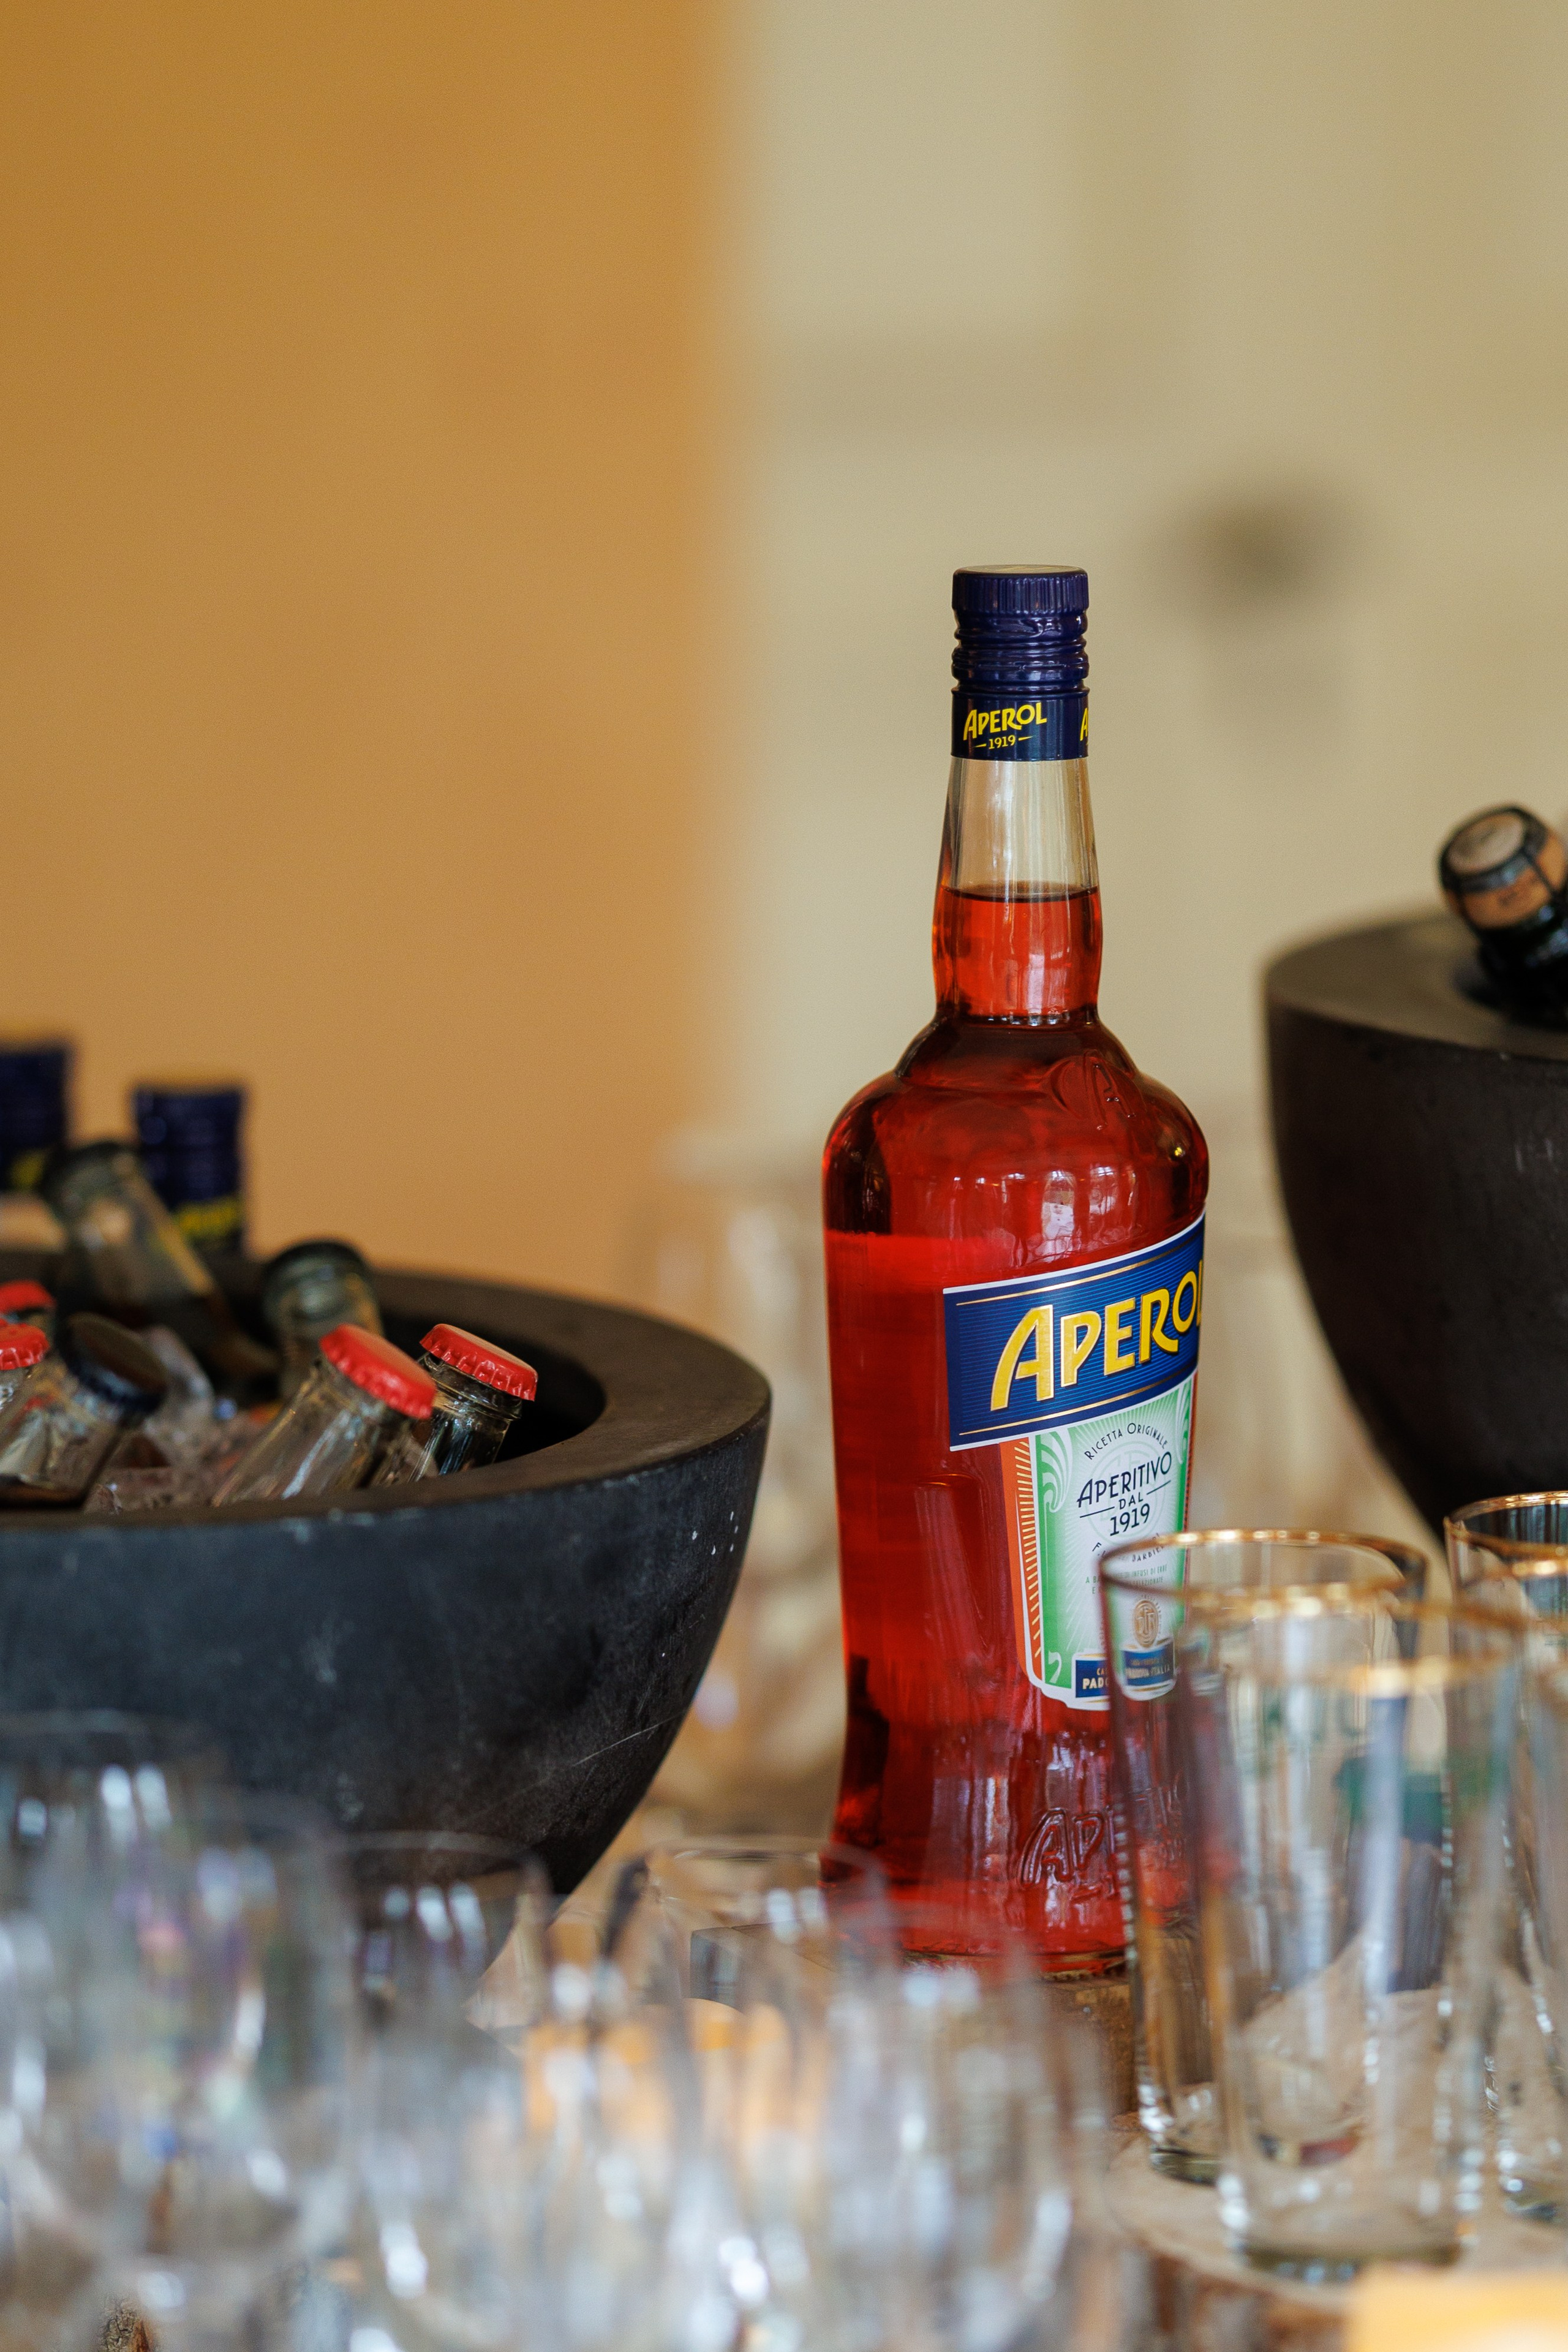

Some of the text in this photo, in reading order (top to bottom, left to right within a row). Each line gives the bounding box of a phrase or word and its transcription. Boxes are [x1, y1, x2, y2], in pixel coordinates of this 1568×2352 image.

[963, 702, 1047, 741] APEROL
[989, 735, 1016, 750] 1919
[1084, 1422, 1168, 1460] RICETTA ORIGINALE
[1076, 1451, 1172, 1508] APERITIVO
[1118, 1492, 1144, 1510] DAL
[1109, 1503, 1150, 1537] 1919
